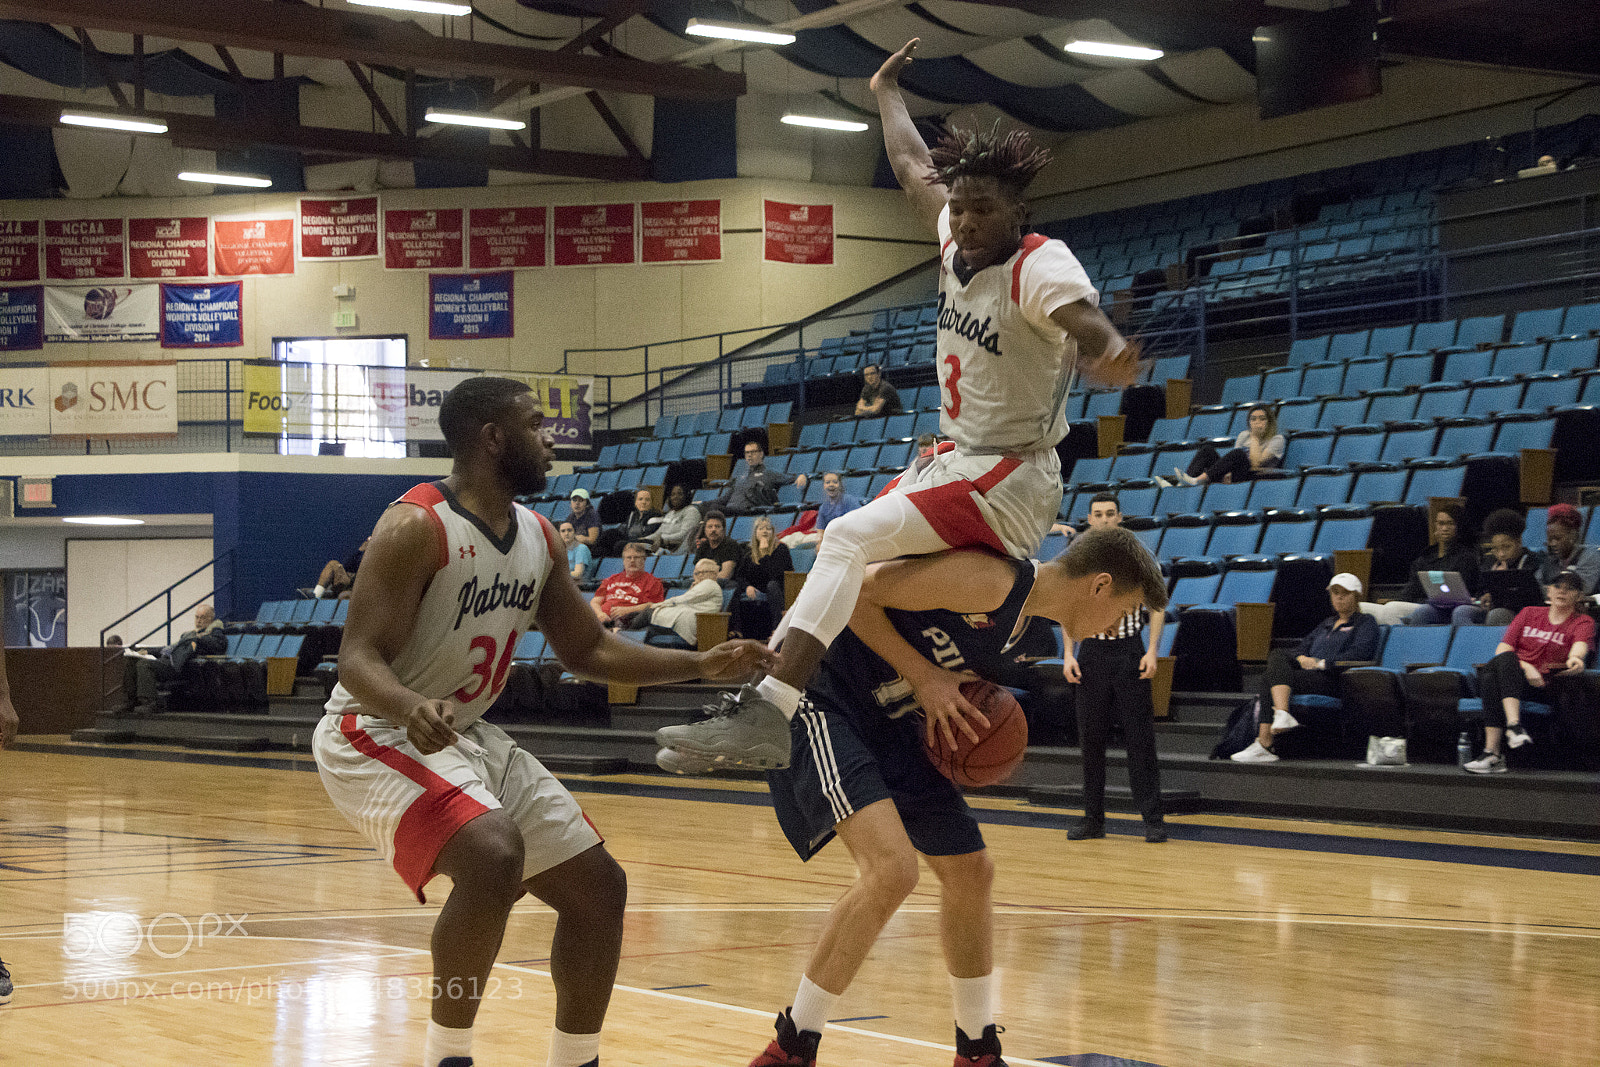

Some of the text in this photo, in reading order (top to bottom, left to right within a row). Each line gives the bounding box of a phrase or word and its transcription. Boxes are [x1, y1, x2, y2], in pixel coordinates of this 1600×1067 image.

[303, 214, 376, 225] REGIONAL CHAMPIONS
[62, 222, 104, 234] NCCAA
[303, 224, 376, 235] WOMEN'S VOLLEYBALL
[46, 235, 122, 245] REGIONAL CHAMPIONS
[130, 240, 206, 248] REGIONAL CHAMPIONS
[322, 236, 351, 245] DIVISION
[60, 246, 108, 256] VOLLEYBALL
[146, 250, 190, 258] VOLLEYBALL
[332, 247, 348, 256] 2011
[61, 257, 92, 266] DIVISION
[152, 259, 180, 267] DIVISION
[434, 292, 508, 301] REGIONAL CHAMPIONS
[166, 300, 238, 312] REGIONAL CHAMPIONS
[434, 302, 508, 313] WOMEN'S VOLLEYBALL
[166, 312, 238, 322] WOMEN'S VOLLEYBALL
[454, 314, 482, 323] DIVISION
[185, 322, 220, 332] DIVISION II
[194, 333, 210, 342] 2014
[944, 354, 962, 420] 3
[90, 380, 166, 412] SMC
